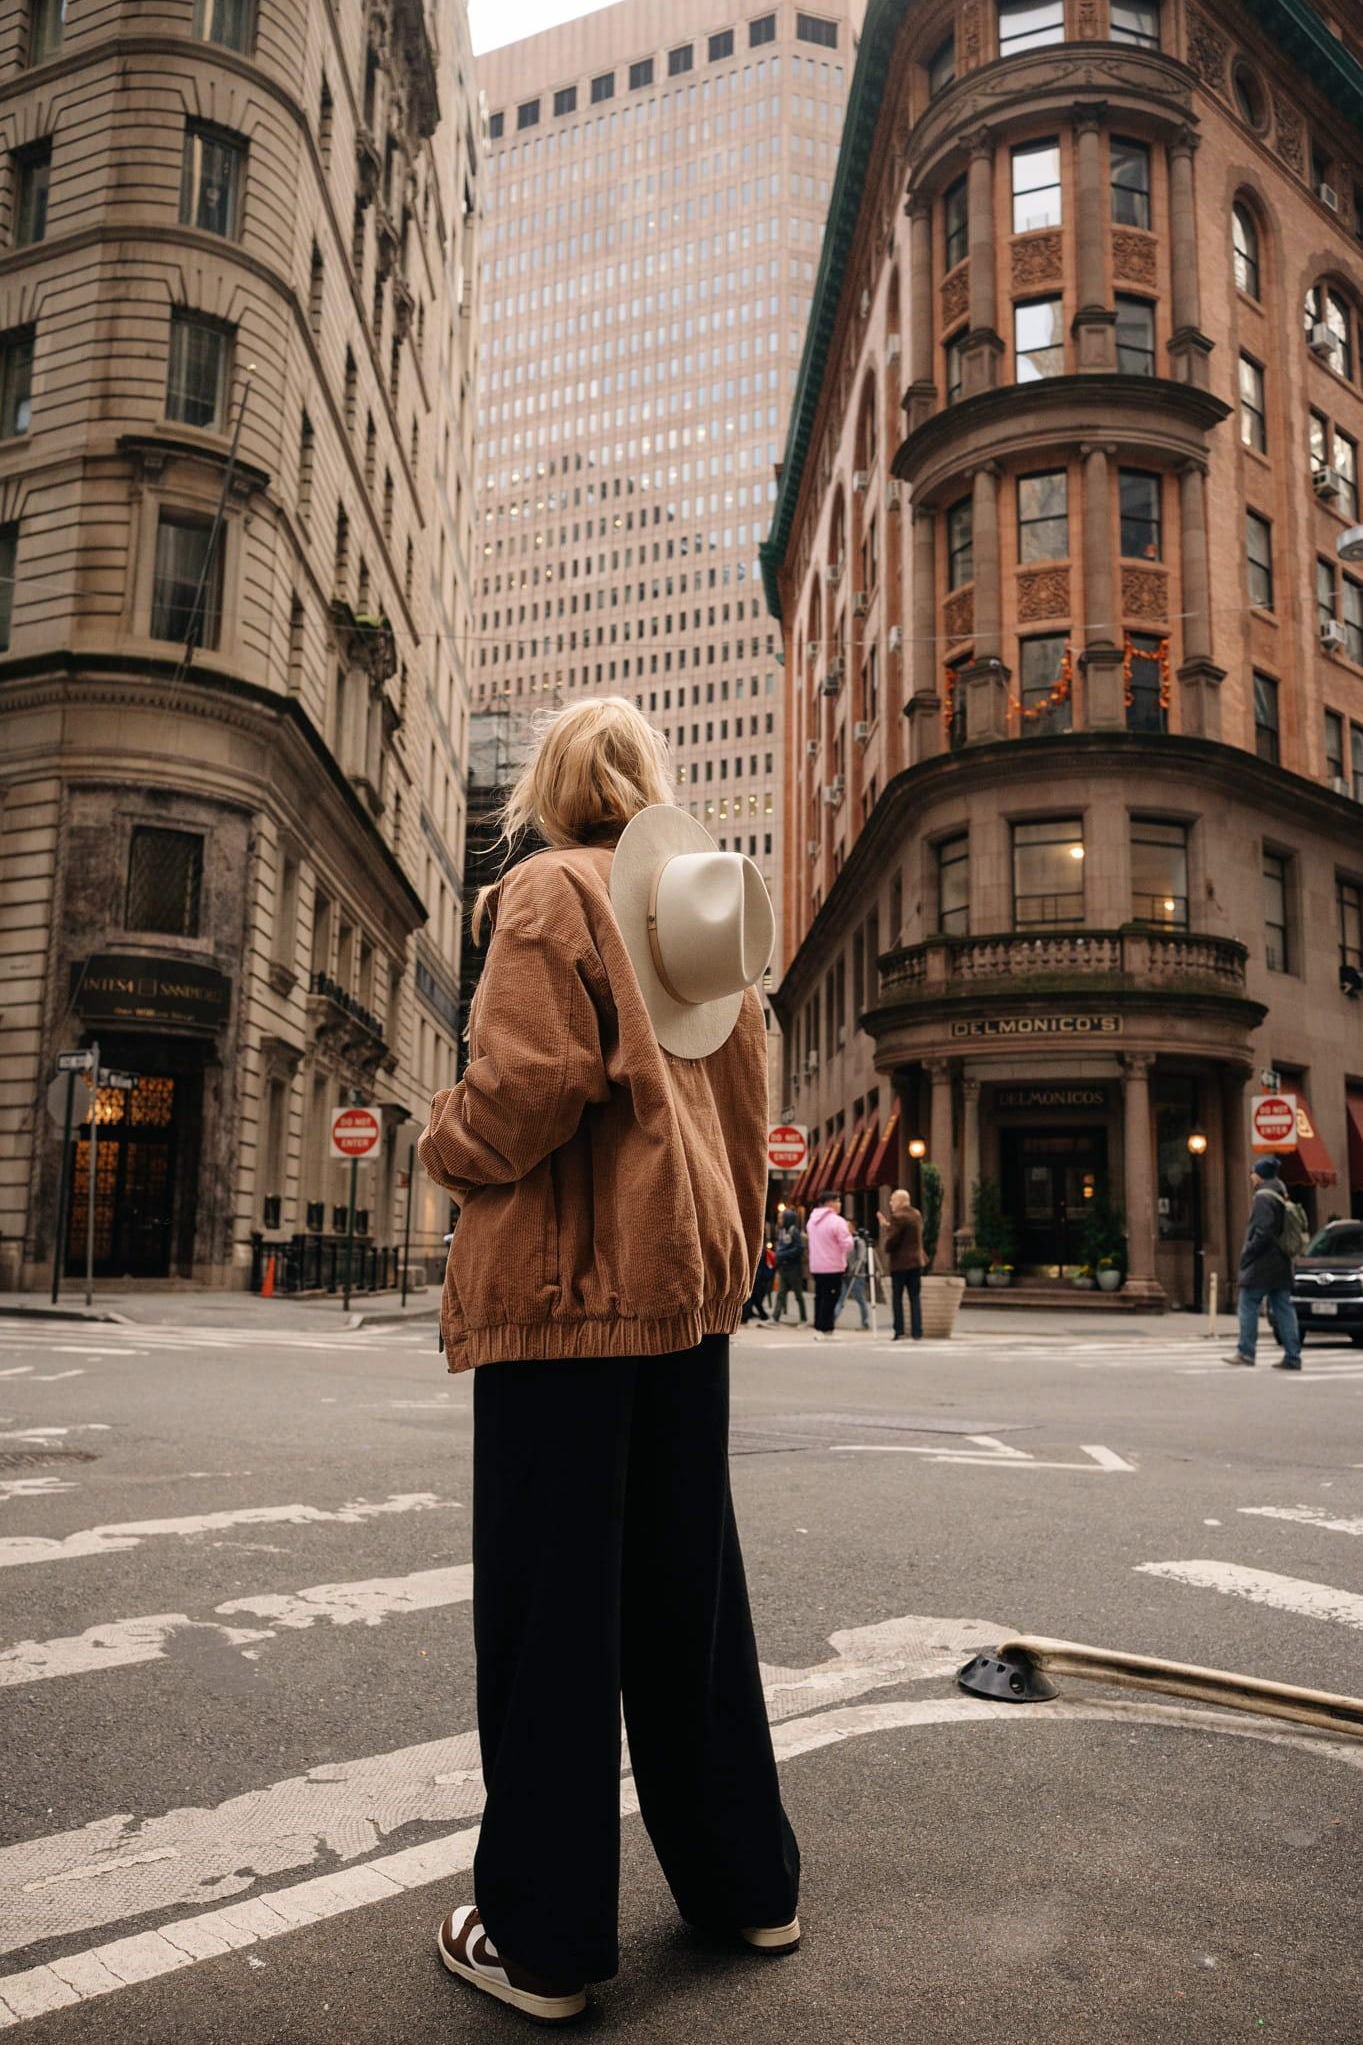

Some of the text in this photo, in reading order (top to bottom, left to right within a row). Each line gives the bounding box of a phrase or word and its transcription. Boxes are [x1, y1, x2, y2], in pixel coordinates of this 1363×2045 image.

[954, 1017, 1116, 1036] DELMONICO'S
[1259, 1104, 1289, 1115] DO NOT
[340, 1117, 372, 1125] DO NOT
[1259, 1125, 1288, 1135] ENTER
[770, 1133, 801, 1142] DO NOT
[341, 1138, 369, 1147] ENTER
[773, 1152, 799, 1161] ENTER
